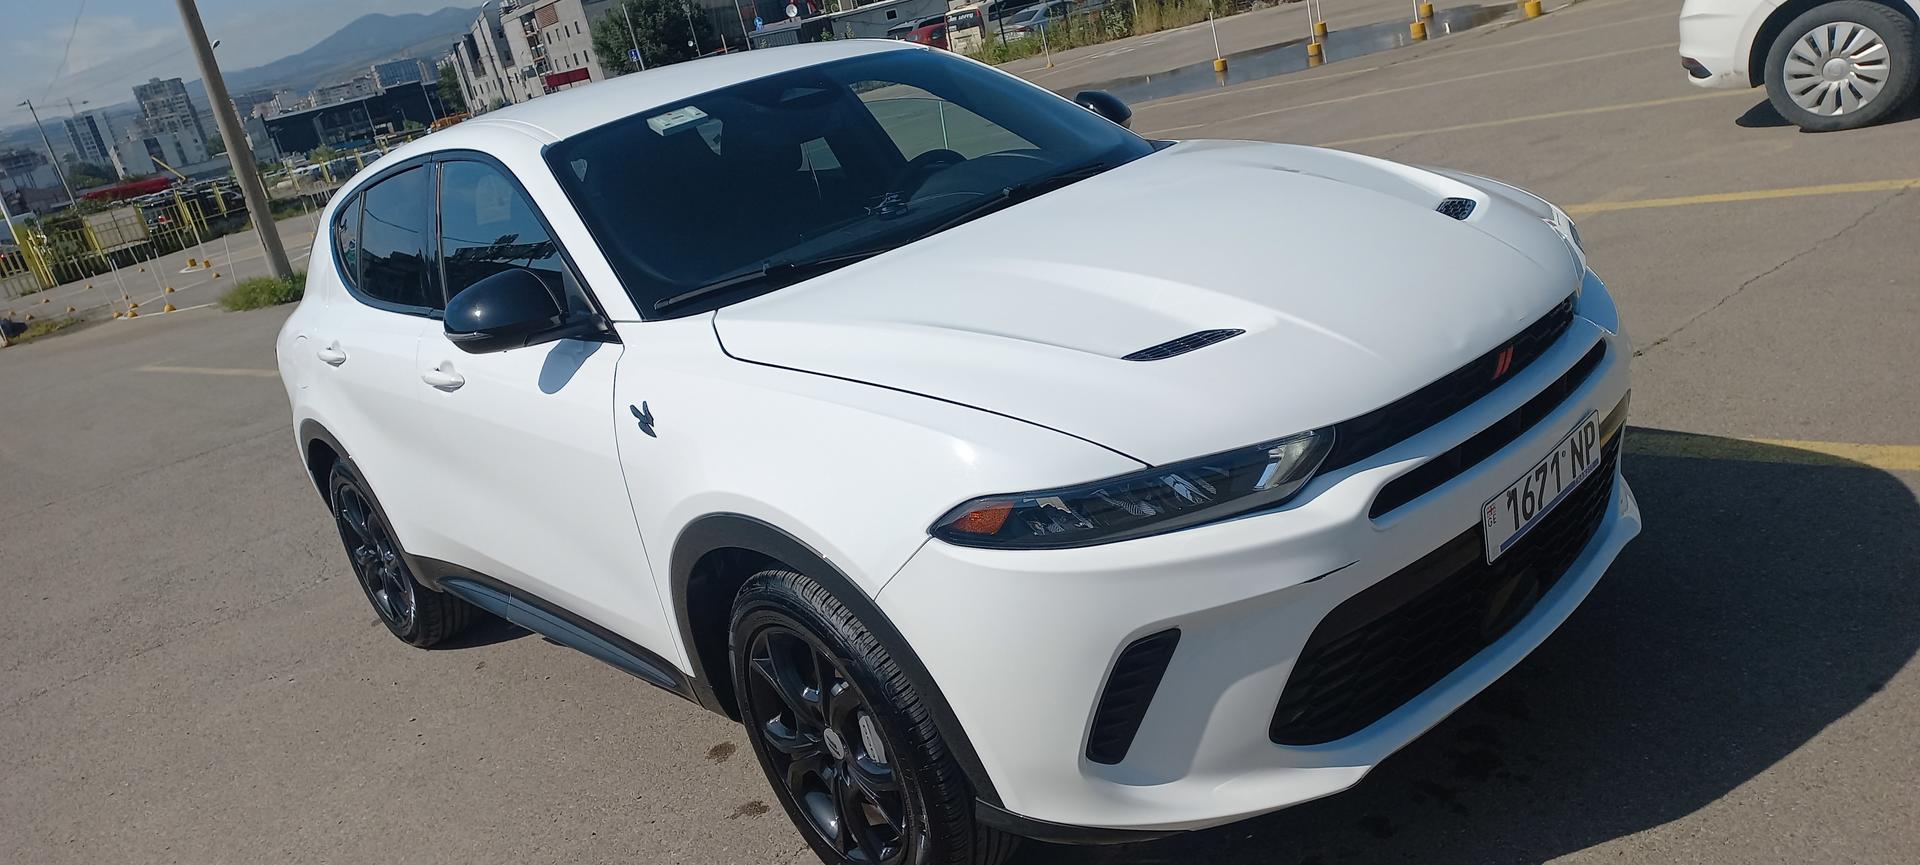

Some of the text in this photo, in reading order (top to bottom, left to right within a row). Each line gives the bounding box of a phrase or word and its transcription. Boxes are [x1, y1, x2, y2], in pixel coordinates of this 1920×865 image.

[1507, 421, 1596, 531] 1671 NP
[1487, 513, 1497, 528] GE
